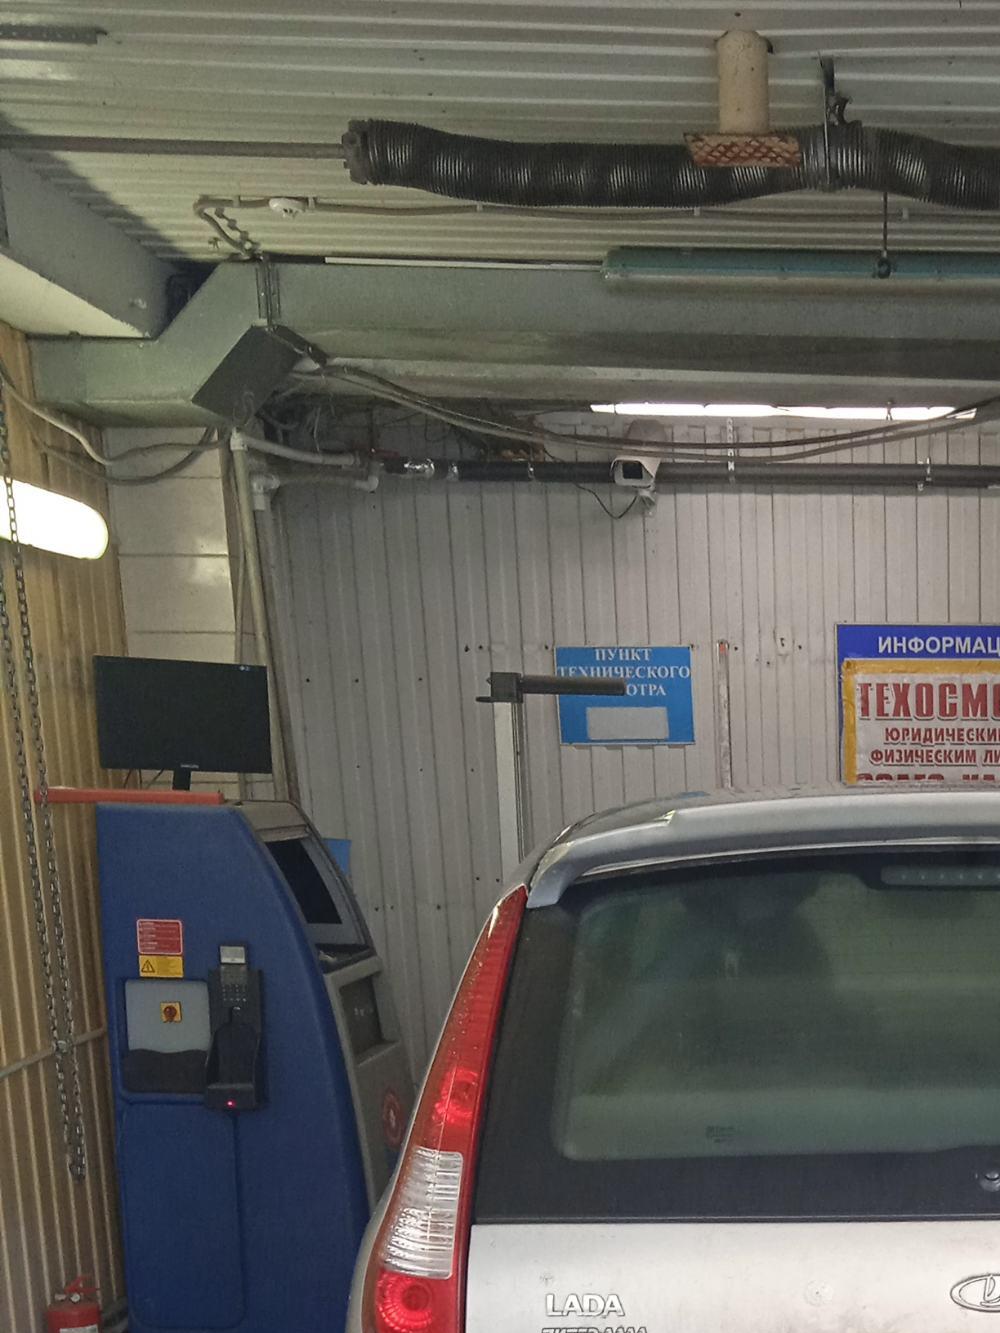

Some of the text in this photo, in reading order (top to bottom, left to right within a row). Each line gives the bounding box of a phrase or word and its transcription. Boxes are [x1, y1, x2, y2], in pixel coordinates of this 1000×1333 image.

[595, 648, 652, 661] ПУНКТ
[557, 665, 690, 678] ТЕХНИЧЕСКОГО
[869, 748, 977, 765] ФИЗИЧЕСКИМ
[545, 1292, 625, 1317] LADA
